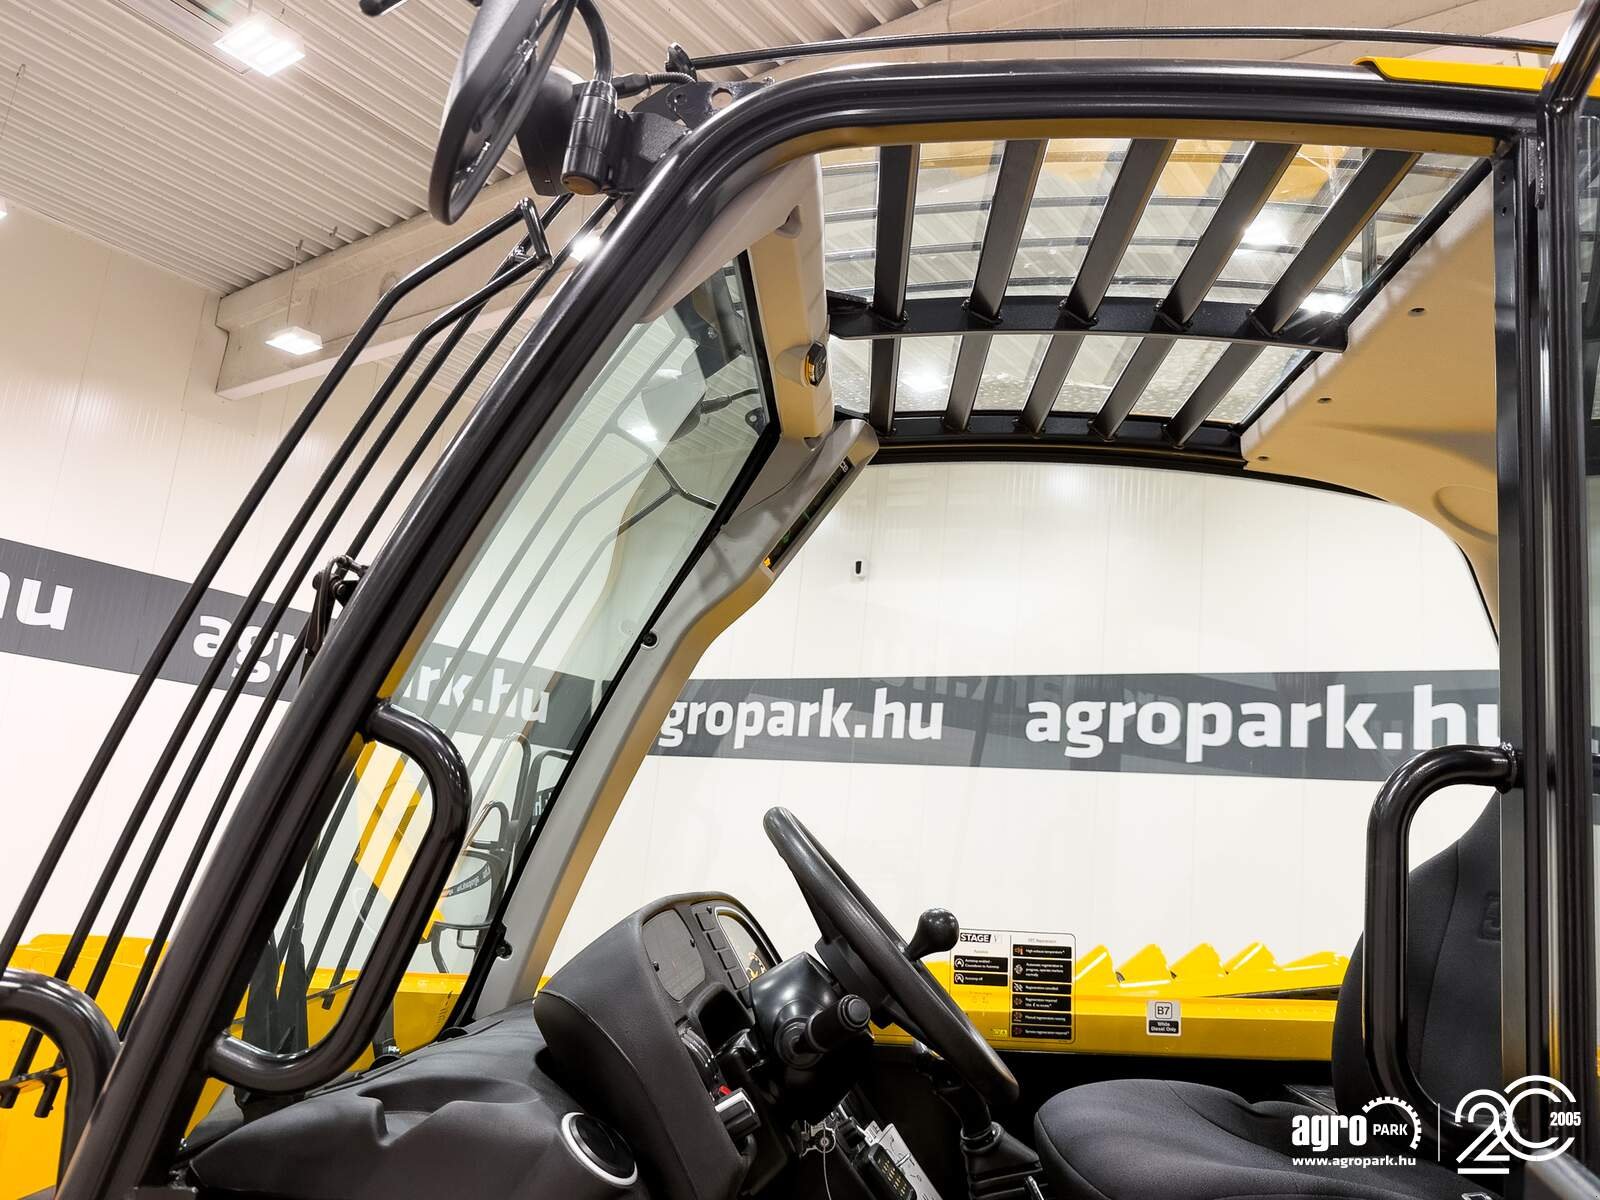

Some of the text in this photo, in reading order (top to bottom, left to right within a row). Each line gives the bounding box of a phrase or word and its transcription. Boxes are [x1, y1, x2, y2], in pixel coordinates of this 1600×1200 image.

[403, 657, 550, 723] rk.hu
[960, 933, 991, 943] STAGE
[1157, 1006, 1170, 1015] B7
